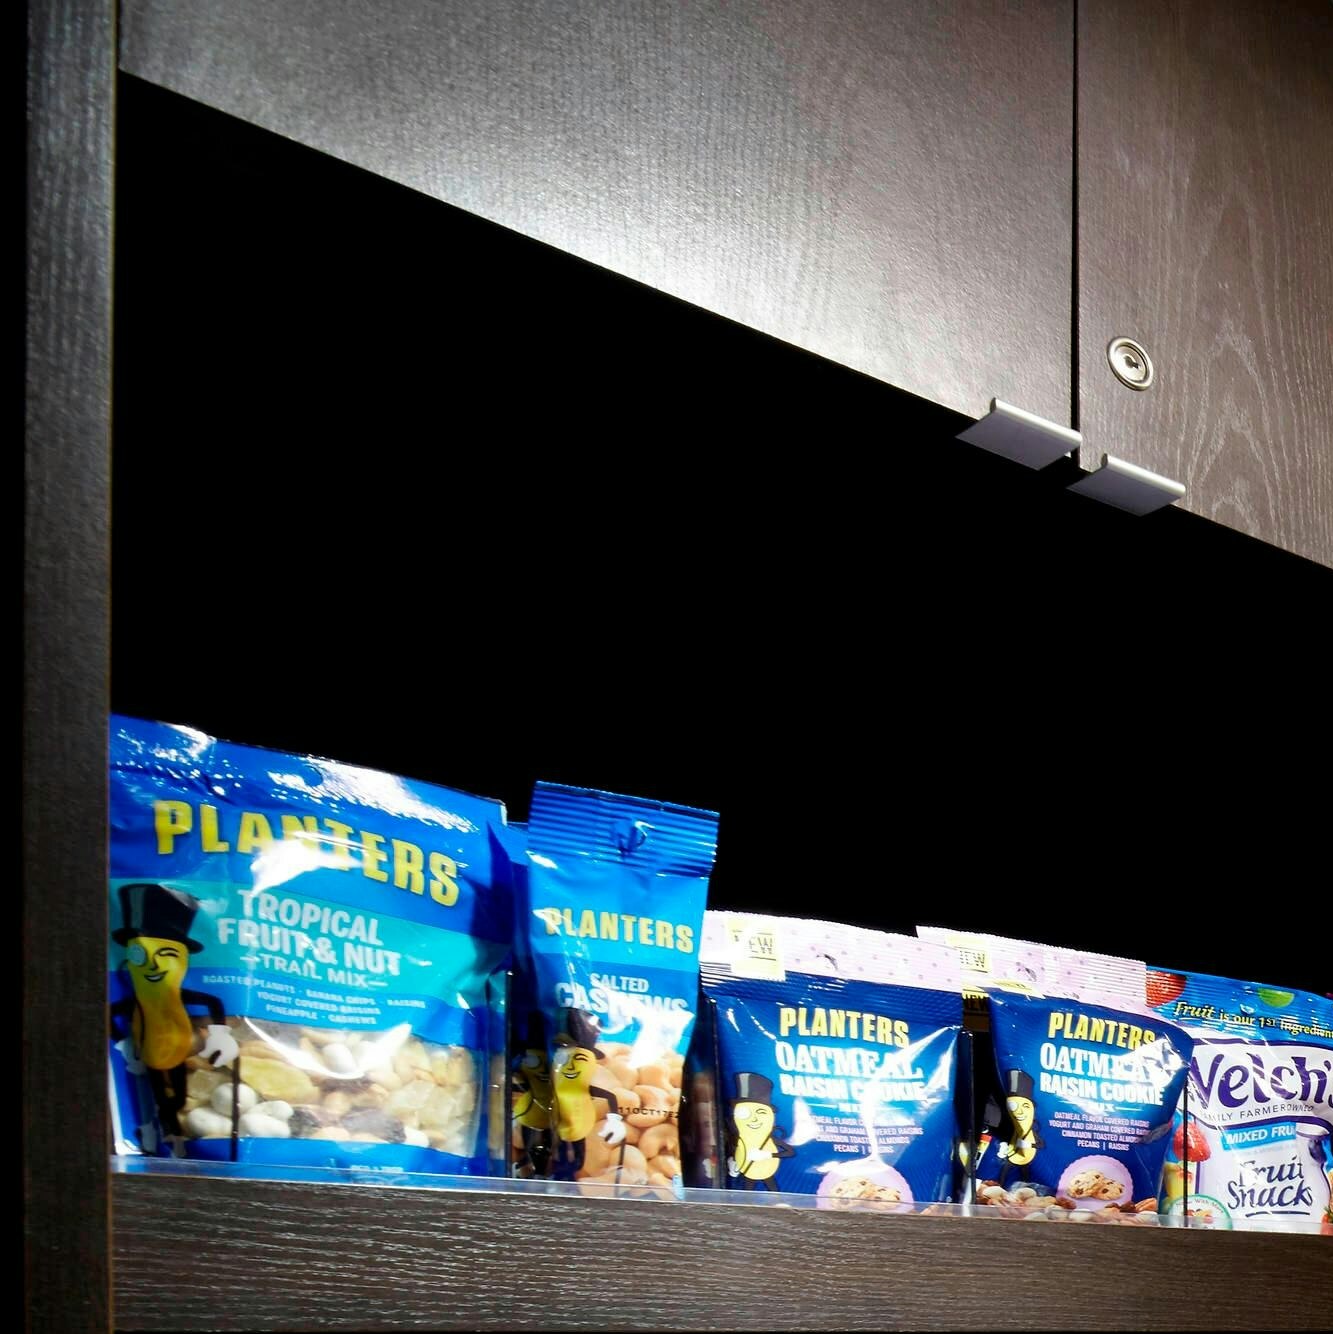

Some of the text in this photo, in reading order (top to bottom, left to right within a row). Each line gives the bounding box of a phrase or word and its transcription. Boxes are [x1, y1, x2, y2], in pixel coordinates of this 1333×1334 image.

[236, 889, 385, 947] TROPICAL
[543, 907, 695, 955] PLANTERS
[343, 941, 402, 977] NUT
[589, 971, 650, 993] SALTED
[779, 1006, 911, 1050] PLANTERS
[1174, 1001, 1216, 1020] Fruit
[1047, 1011, 1157, 1051] PLANTERS
[1039, 1071, 1164, 1106] RAISIN COOKIE
[1226, 1127, 1269, 1146] MIXED
